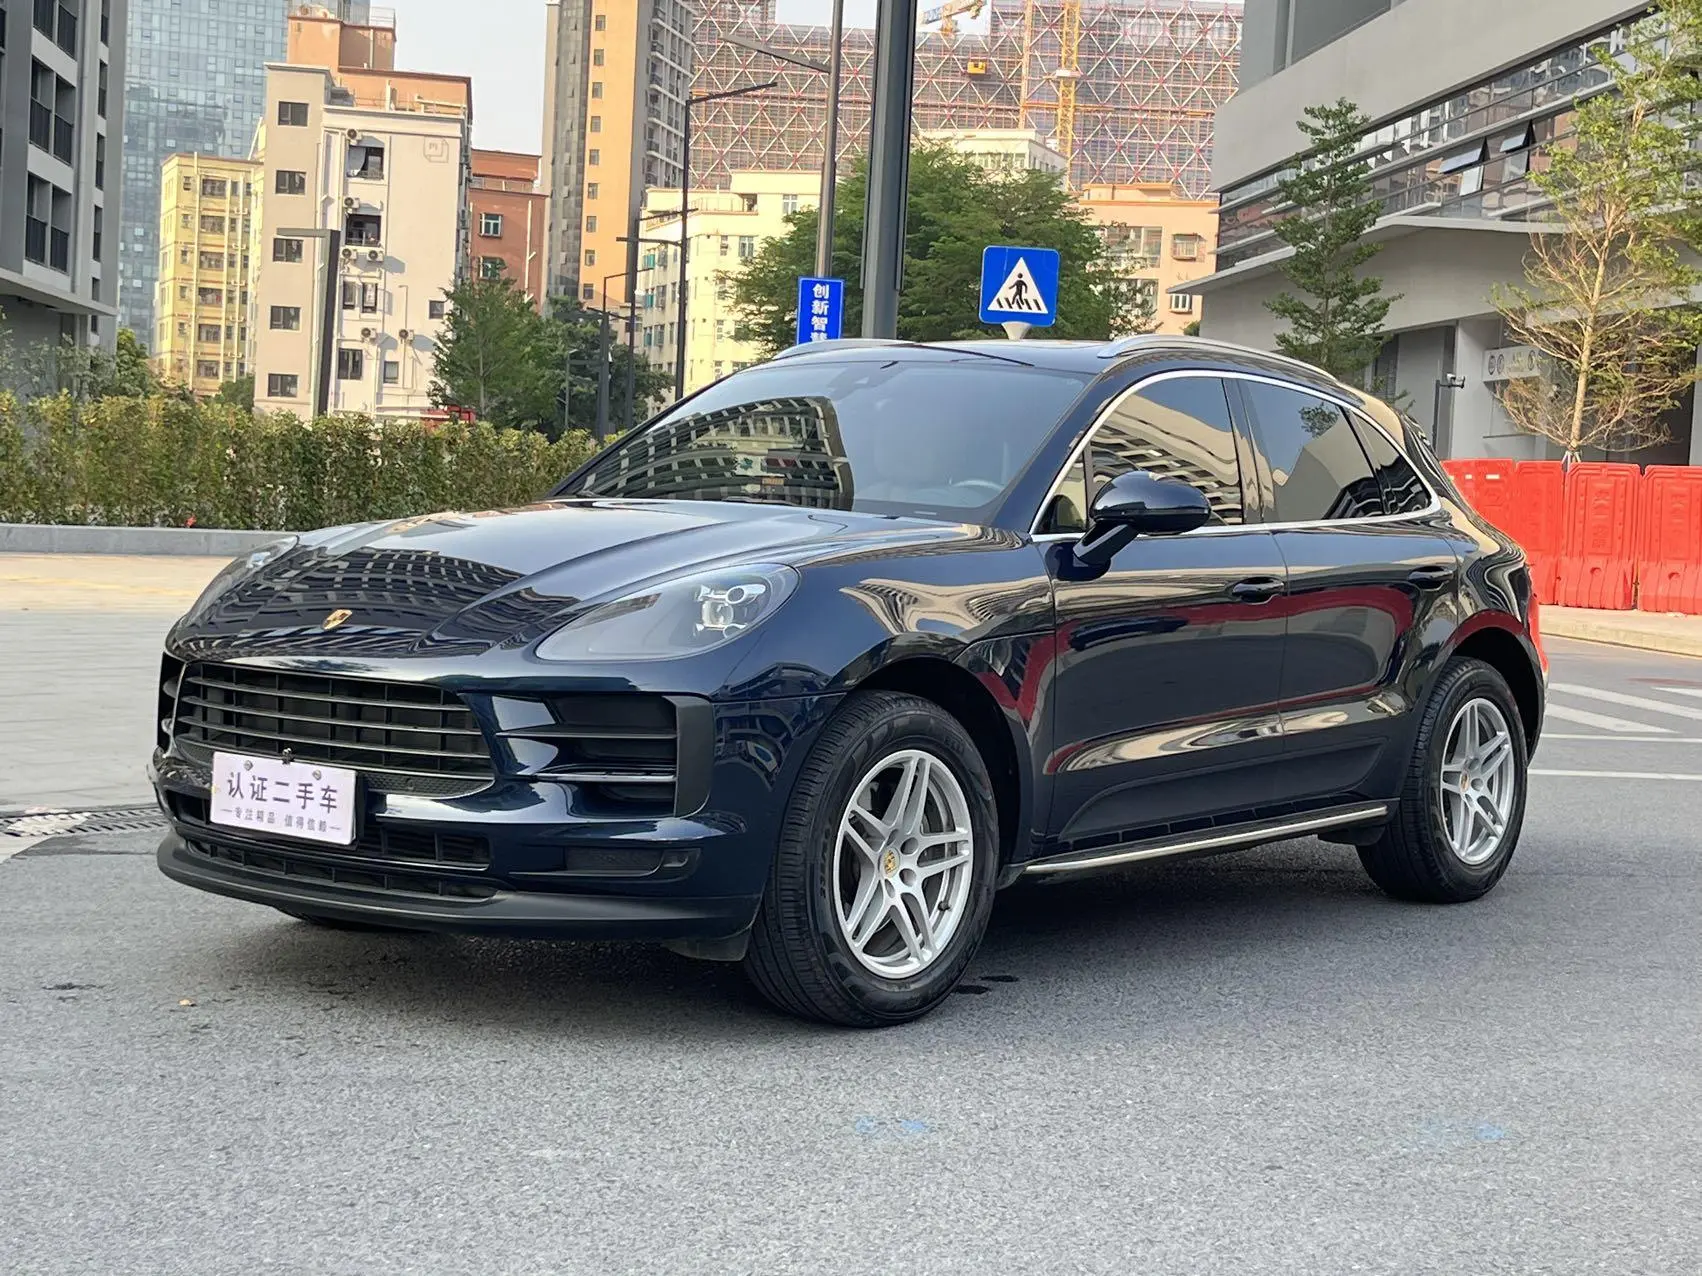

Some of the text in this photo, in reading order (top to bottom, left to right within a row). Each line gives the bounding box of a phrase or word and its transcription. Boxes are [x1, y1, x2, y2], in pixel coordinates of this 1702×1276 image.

[227, 772, 338, 814] 认证二手车
